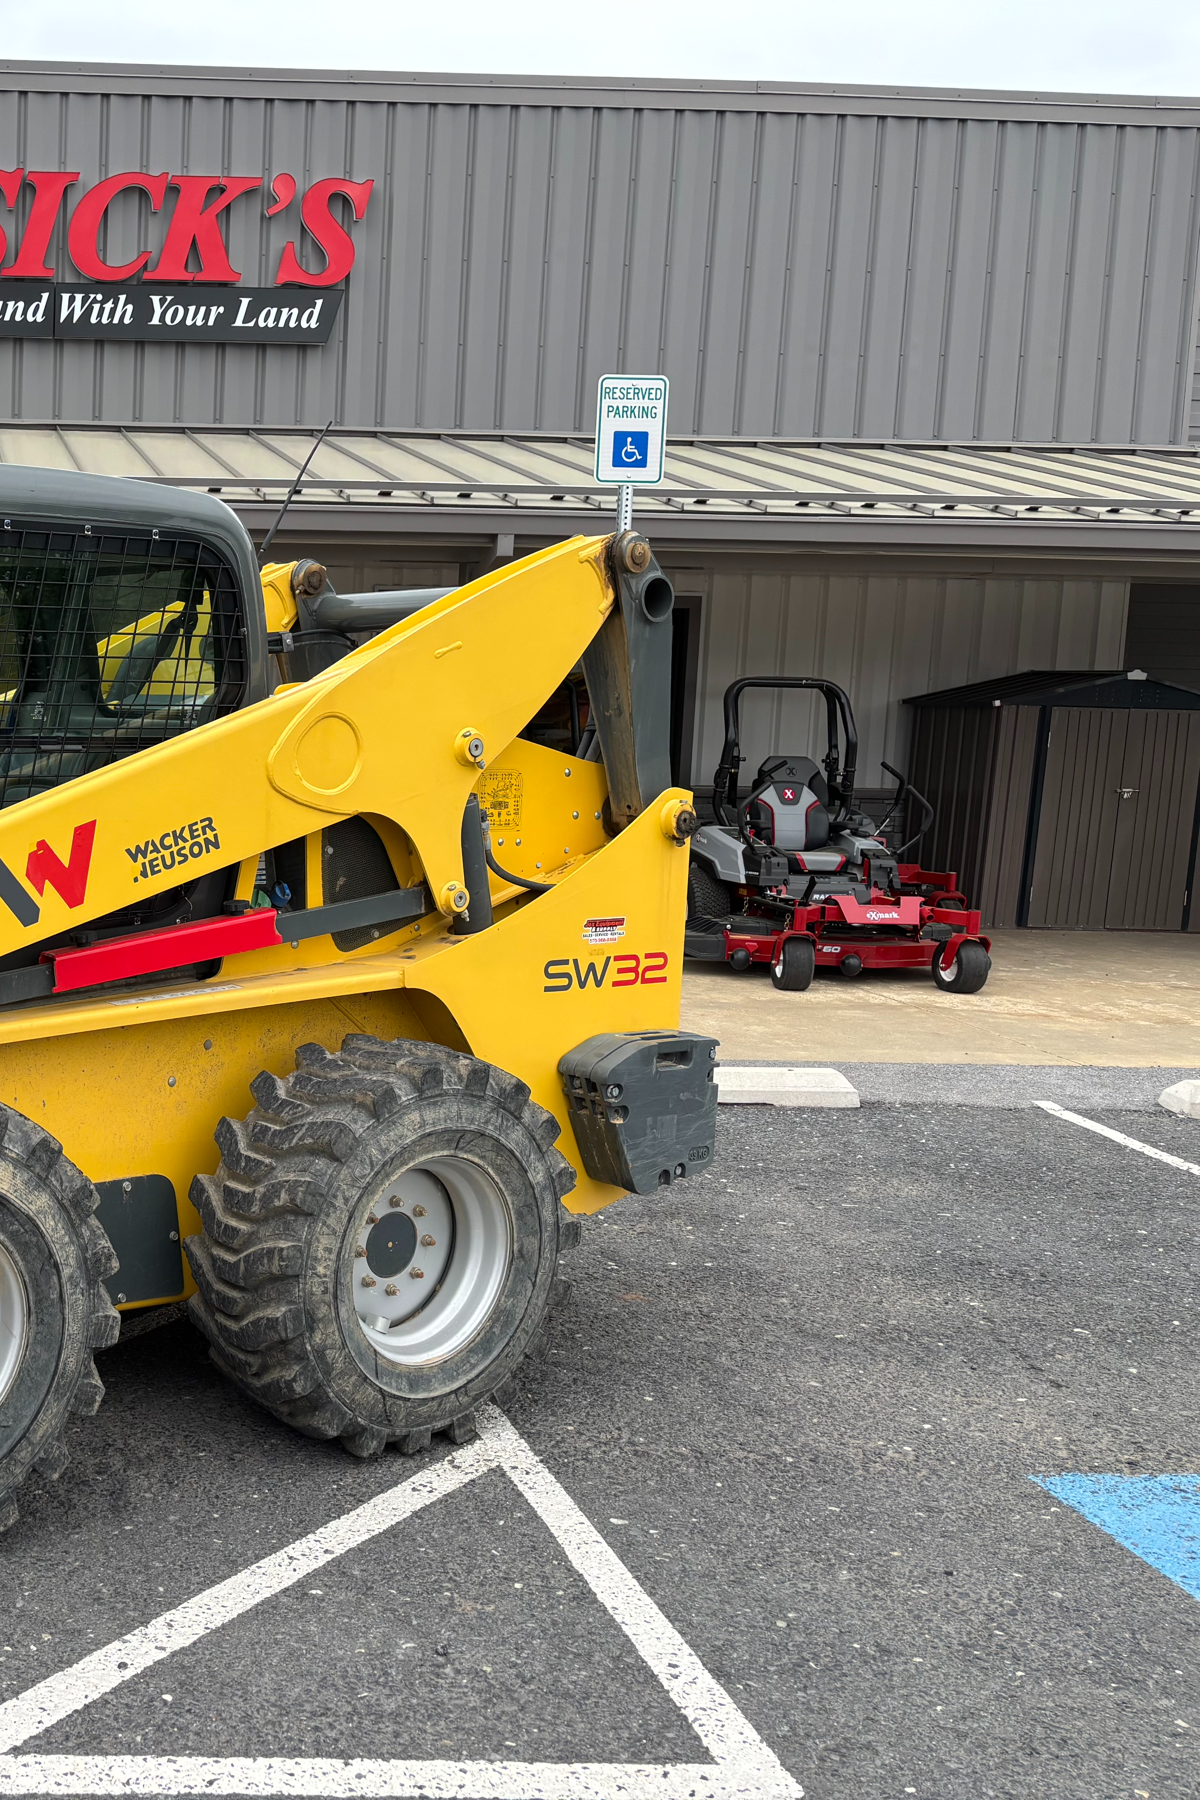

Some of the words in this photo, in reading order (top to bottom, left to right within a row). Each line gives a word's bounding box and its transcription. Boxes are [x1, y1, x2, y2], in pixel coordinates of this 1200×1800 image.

[59, 292, 134, 324] With
[147, 295, 224, 327] Your
[231, 297, 324, 329] Land
[603, 386, 663, 401] RESERVED
[606, 405, 658, 419] PARKING
[125, 816, 217, 864] WACKER
[544, 952, 668, 992] SW32
